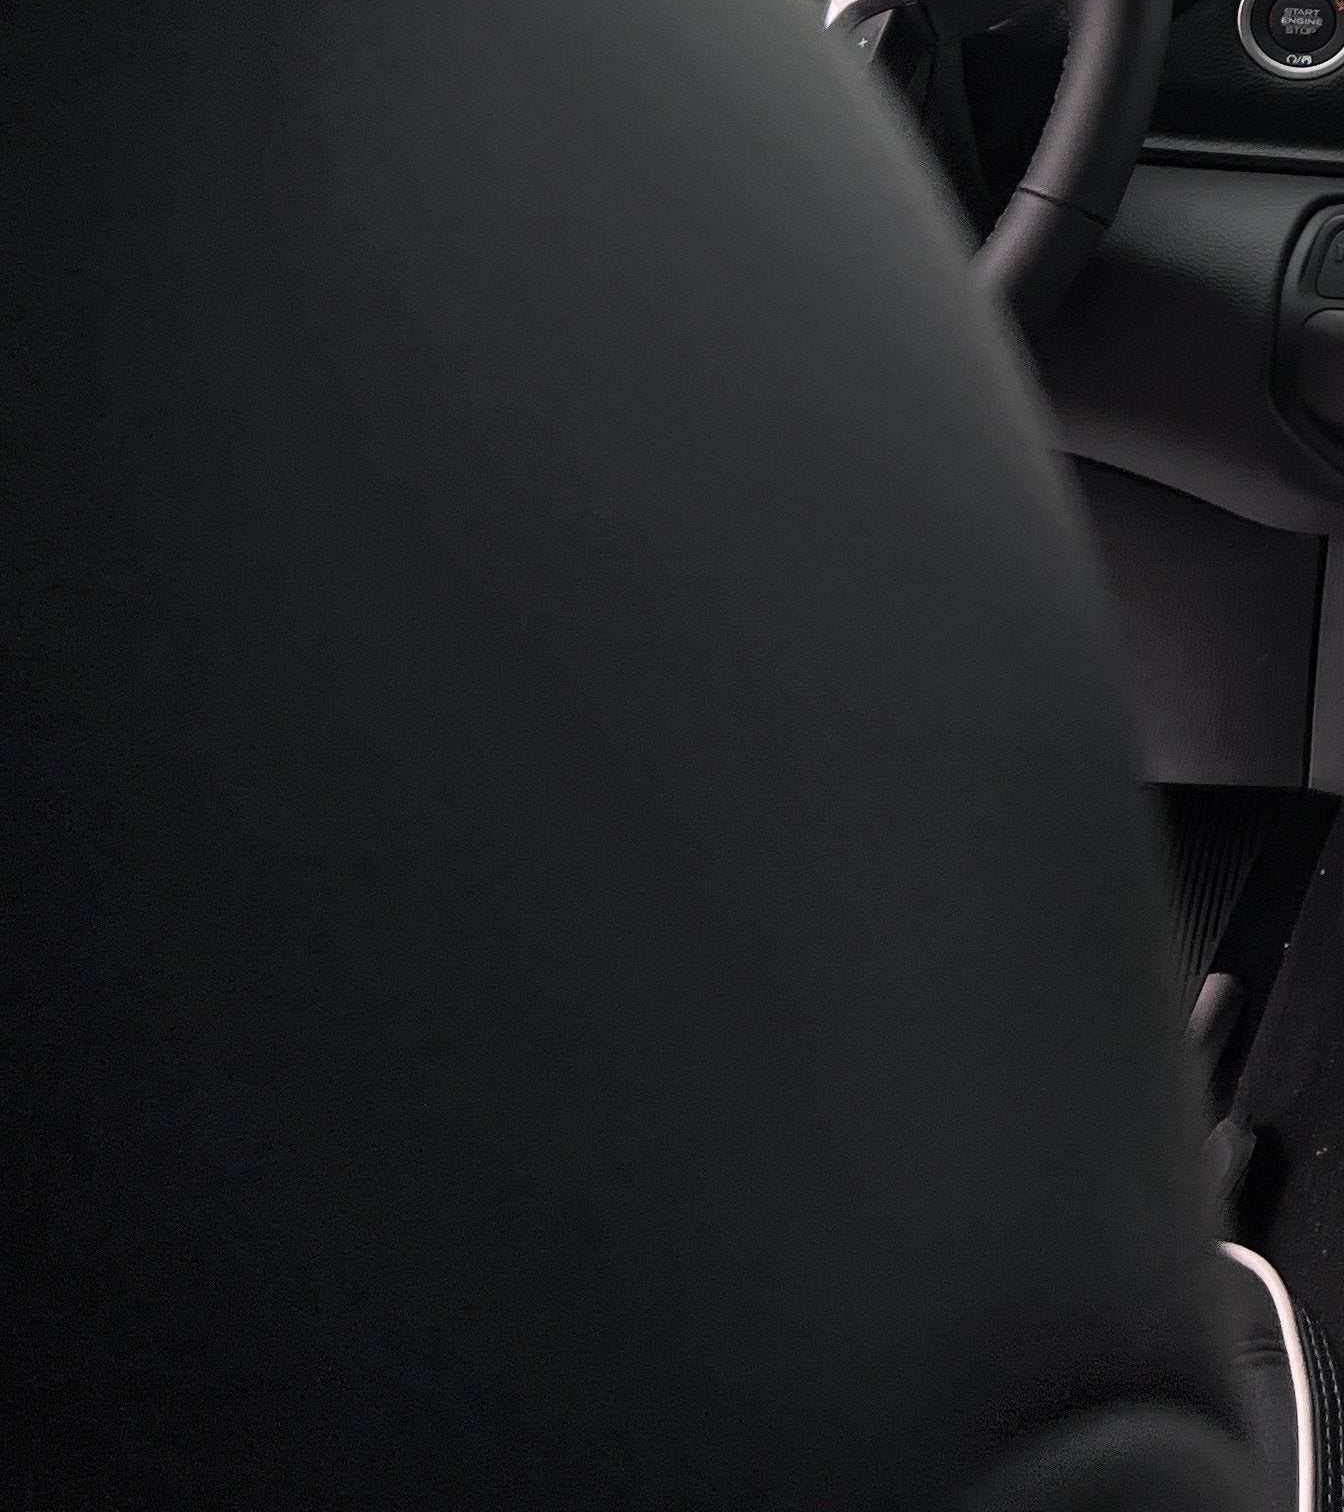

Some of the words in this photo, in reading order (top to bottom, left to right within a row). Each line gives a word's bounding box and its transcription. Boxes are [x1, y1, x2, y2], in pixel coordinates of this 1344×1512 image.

[1283, 8, 1320, 17] START
[1281, 16, 1323, 26] ENGINE
[1286, 26, 1316, 35] STOP
